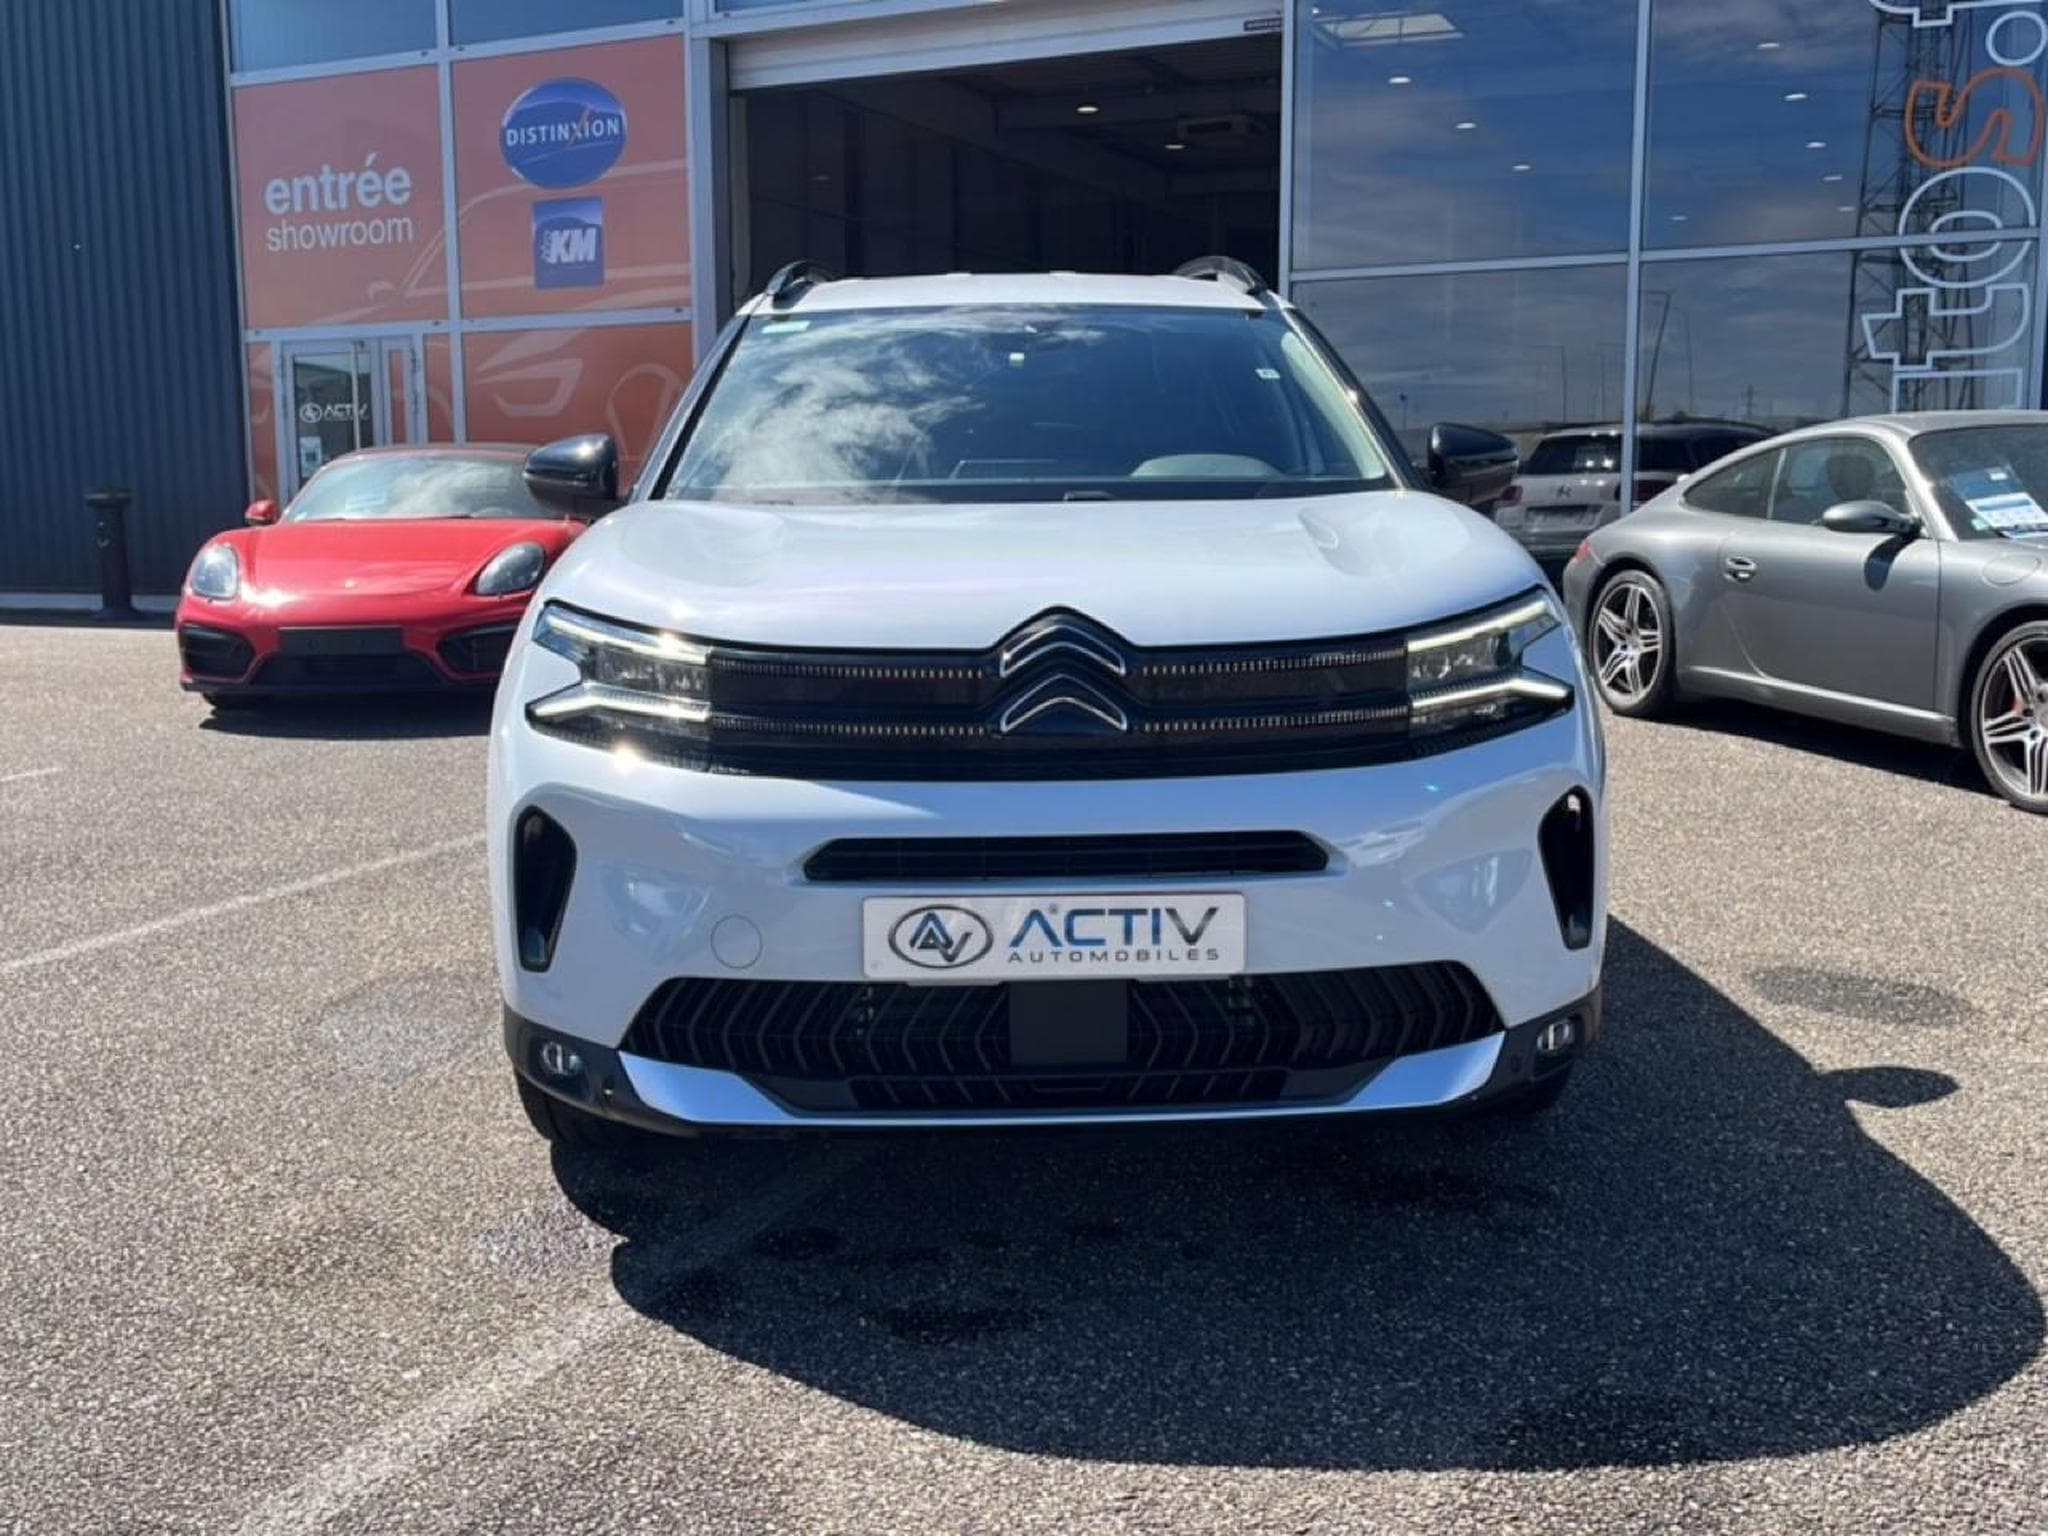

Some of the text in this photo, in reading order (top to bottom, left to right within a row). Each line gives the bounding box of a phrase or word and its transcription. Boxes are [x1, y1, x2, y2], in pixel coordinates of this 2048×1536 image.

[506, 118, 620, 147] DISTINXION
[265, 152, 411, 214] entrée
[267, 217, 412, 251] showroom
[549, 227, 597, 264] KM
[1008, 906, 1219, 948] ACTIV
[1008, 948, 1220, 963] AUTOMOBILES
